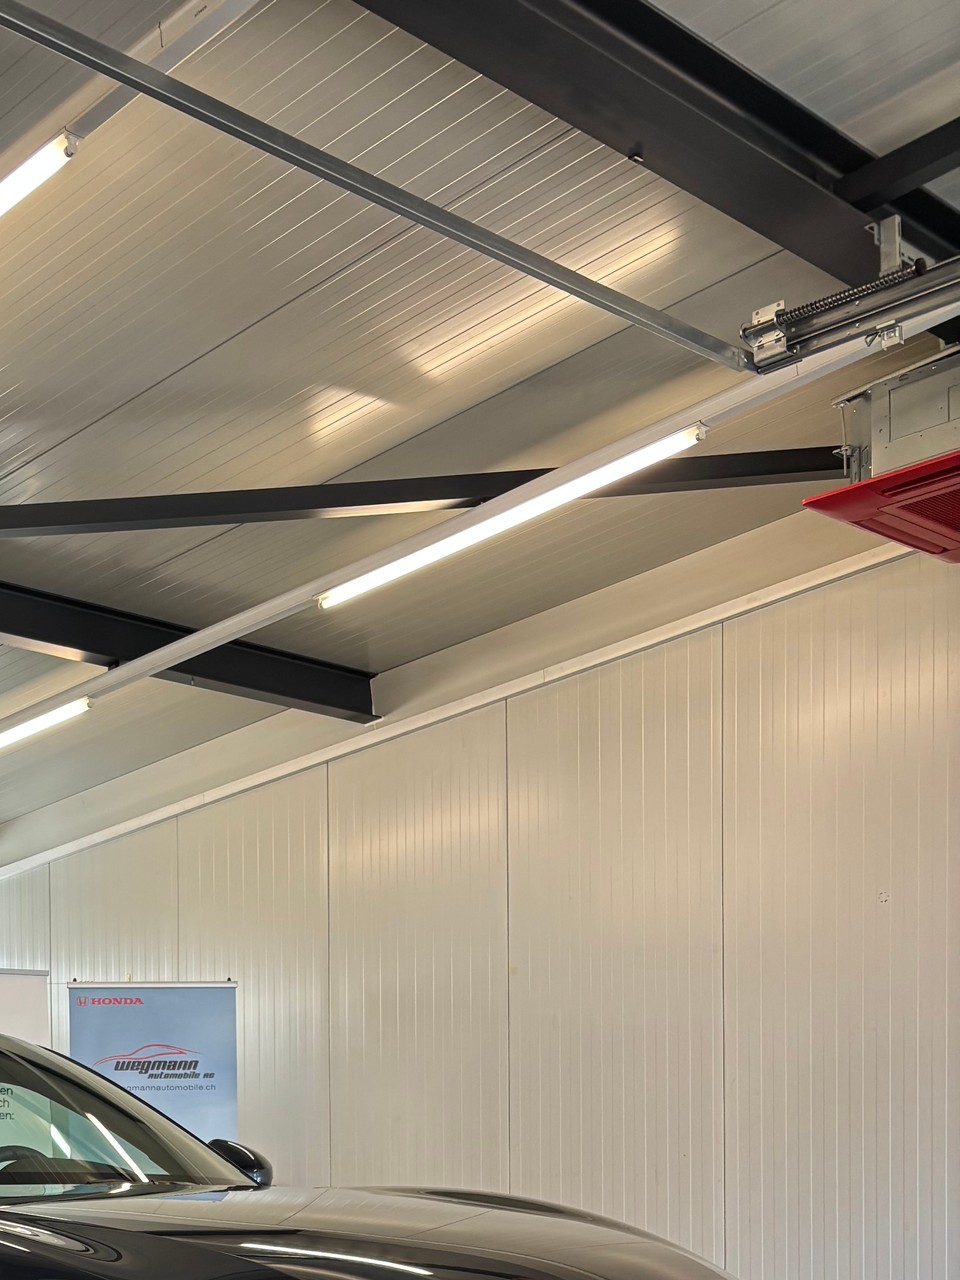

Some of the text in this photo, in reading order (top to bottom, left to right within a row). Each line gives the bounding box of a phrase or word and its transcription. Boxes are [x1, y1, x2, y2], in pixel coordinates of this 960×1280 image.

[91, 997, 144, 1006] HONDA
[114, 1060, 199, 1074] wegmann
[126, 1084, 216, 1092] gmannautomobile.ch
